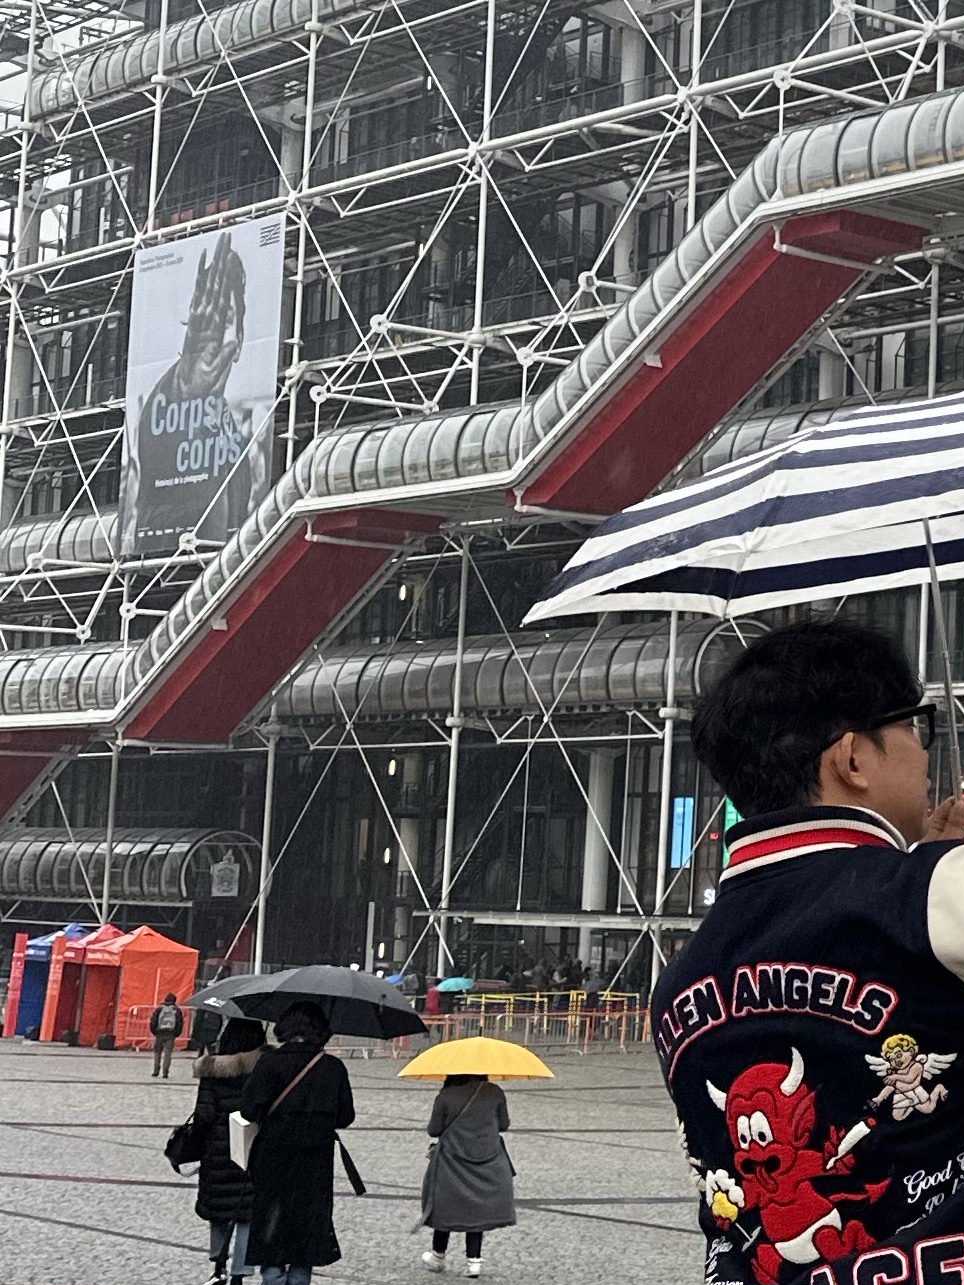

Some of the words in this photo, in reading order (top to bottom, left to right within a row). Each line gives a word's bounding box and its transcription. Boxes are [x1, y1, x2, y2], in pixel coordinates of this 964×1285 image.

[150, 393, 216, 440] Corps
[176, 432, 242, 477] corps
[657, 975, 728, 1060] LLEN
[731, 962, 899, 1036] ANGELS
[903, 1159, 954, 1204] Good
